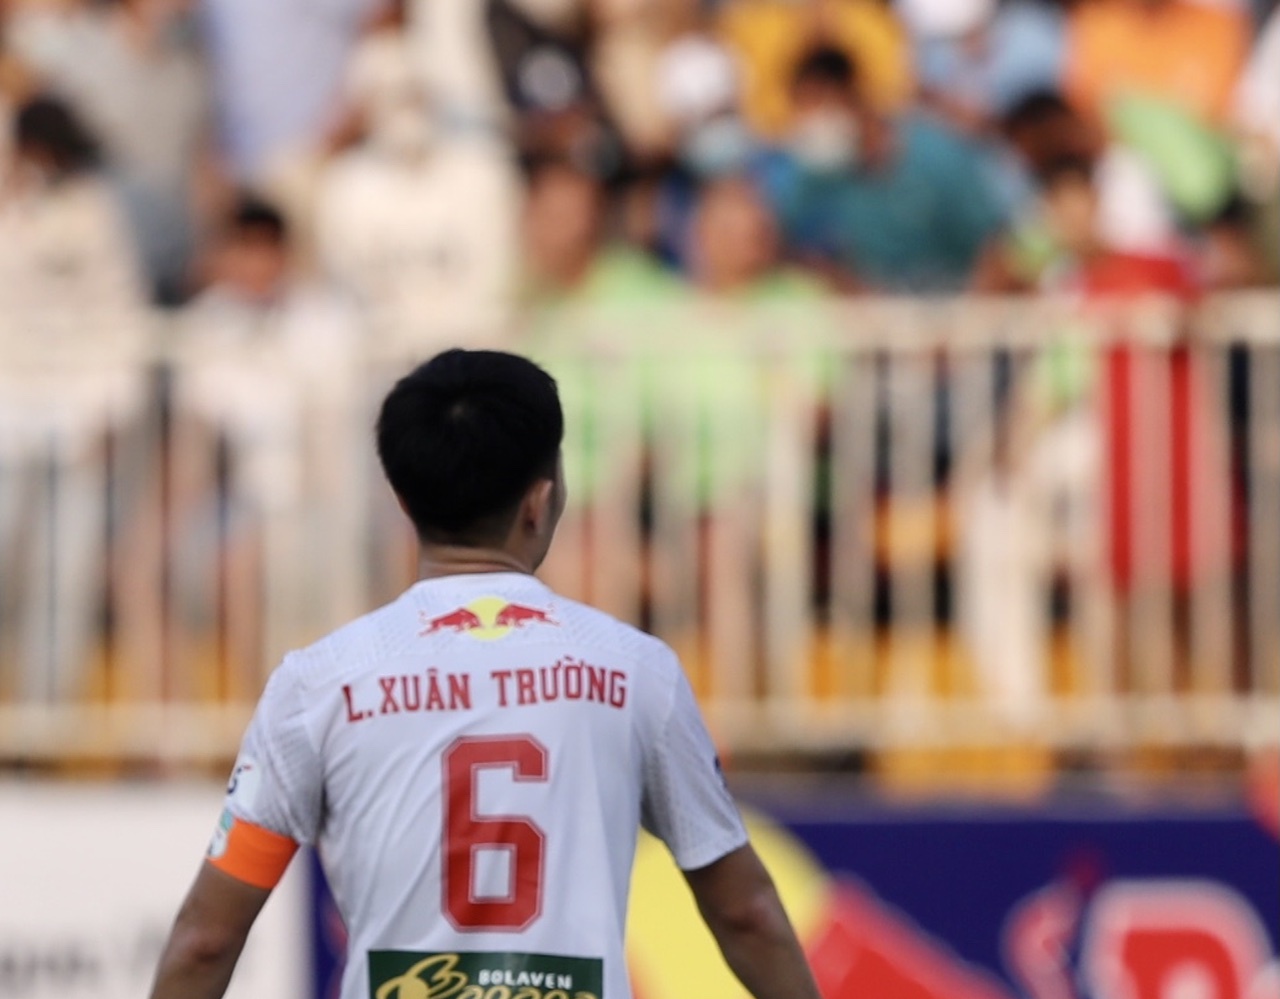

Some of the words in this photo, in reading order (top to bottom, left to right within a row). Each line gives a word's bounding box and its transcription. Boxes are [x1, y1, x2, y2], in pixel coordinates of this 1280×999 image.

[342, 668, 472, 723] L.XUÂN
[491, 655, 627, 709] TRƯỜNG
[441, 733, 549, 934] 6
[478, 969, 573, 990] BOLAVEN
